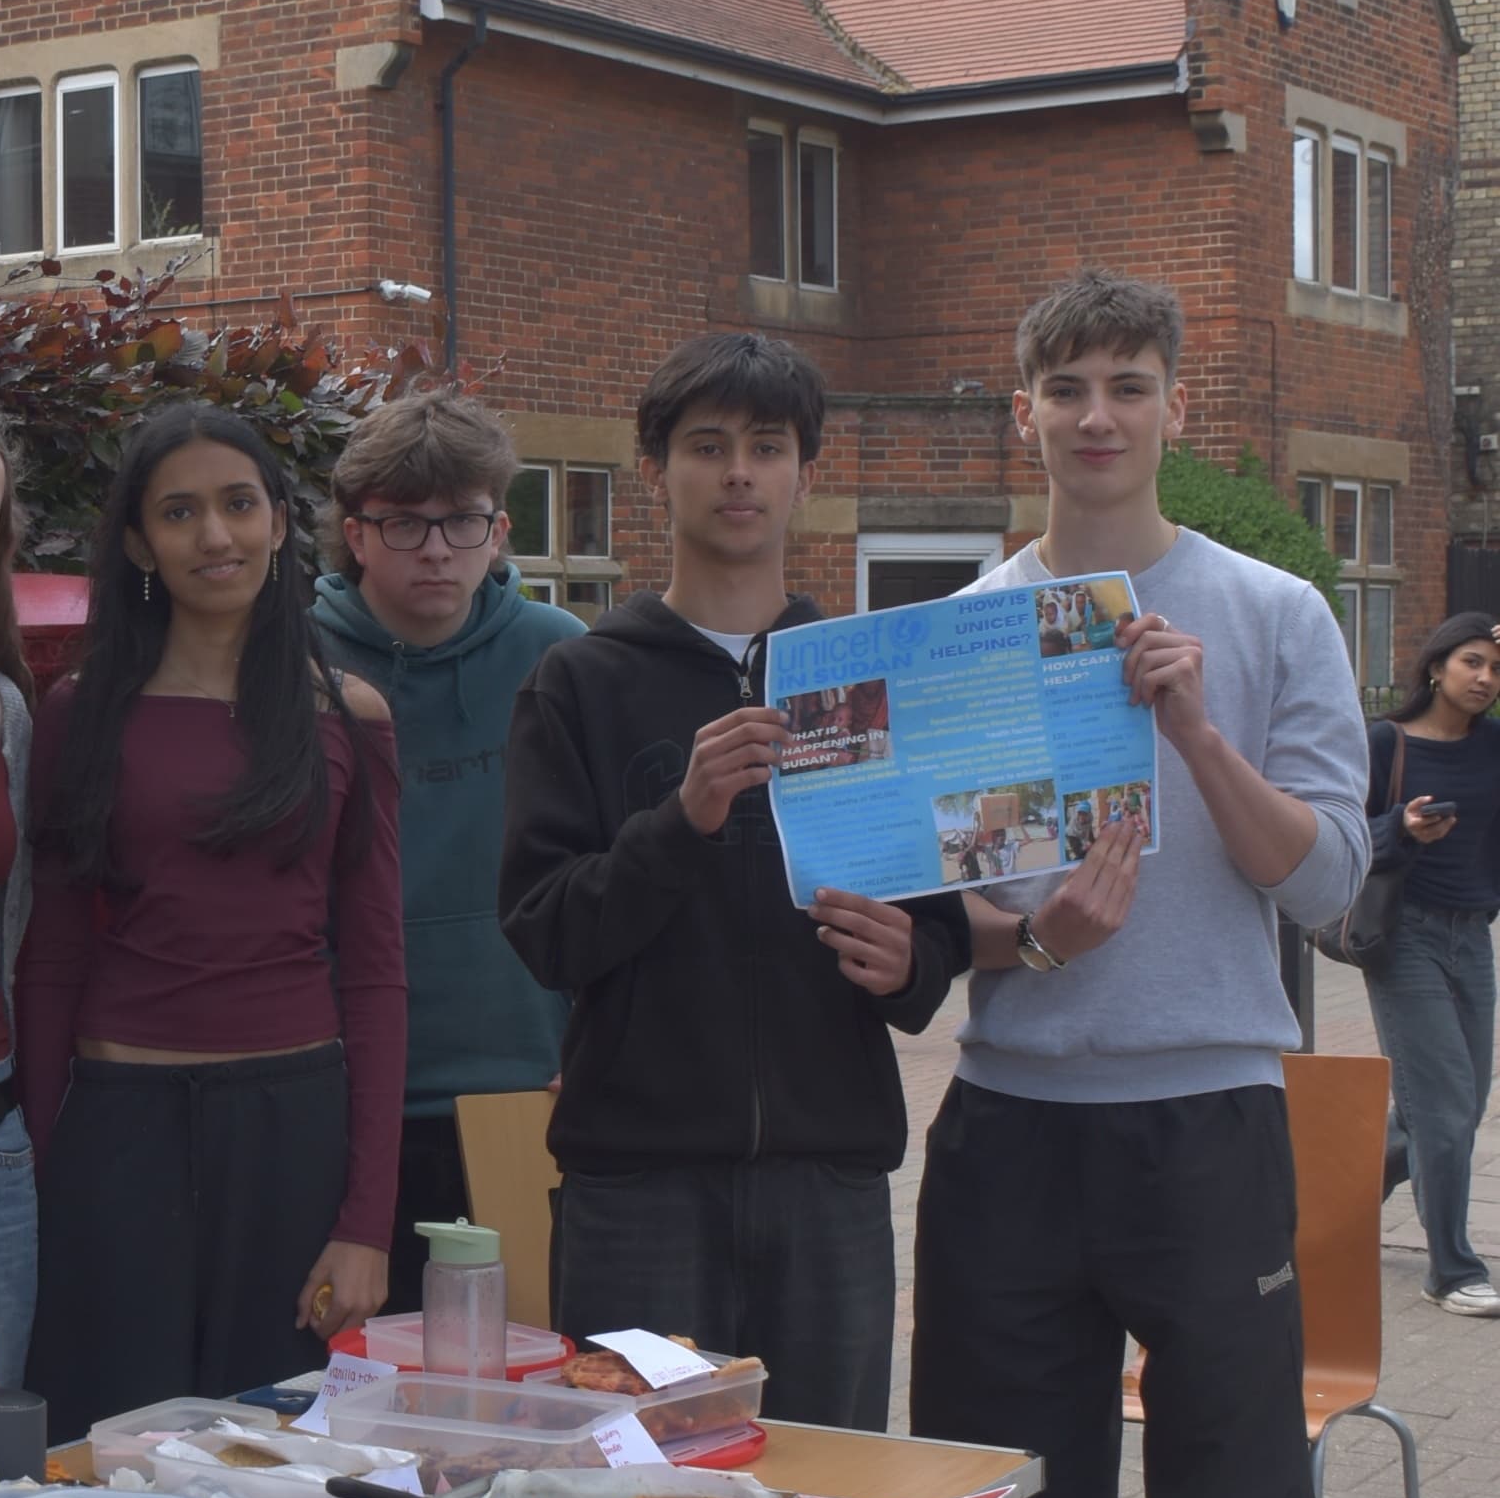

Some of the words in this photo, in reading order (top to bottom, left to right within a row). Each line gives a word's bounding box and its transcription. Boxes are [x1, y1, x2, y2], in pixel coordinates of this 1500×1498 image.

[959, 596, 1005, 614] HOW
[1010, 593, 1028, 605] IS
[956, 613, 1029, 635] UNICEF
[777, 616, 884, 673] unicef
[929, 633, 1031, 660] HELPING?
[777, 673, 806, 691] IN
[814, 652, 913, 684] SUDAN
[1043, 660, 1077, 672] HOW
[1079, 655, 1110, 667] CAN
[1043, 671, 1090, 686] HELP?
[825, 725, 839, 735] IS
[782, 734, 867, 757] HAPPENING
[868, 730, 885, 741] IN
[782, 752, 839, 770] SUDAN?
